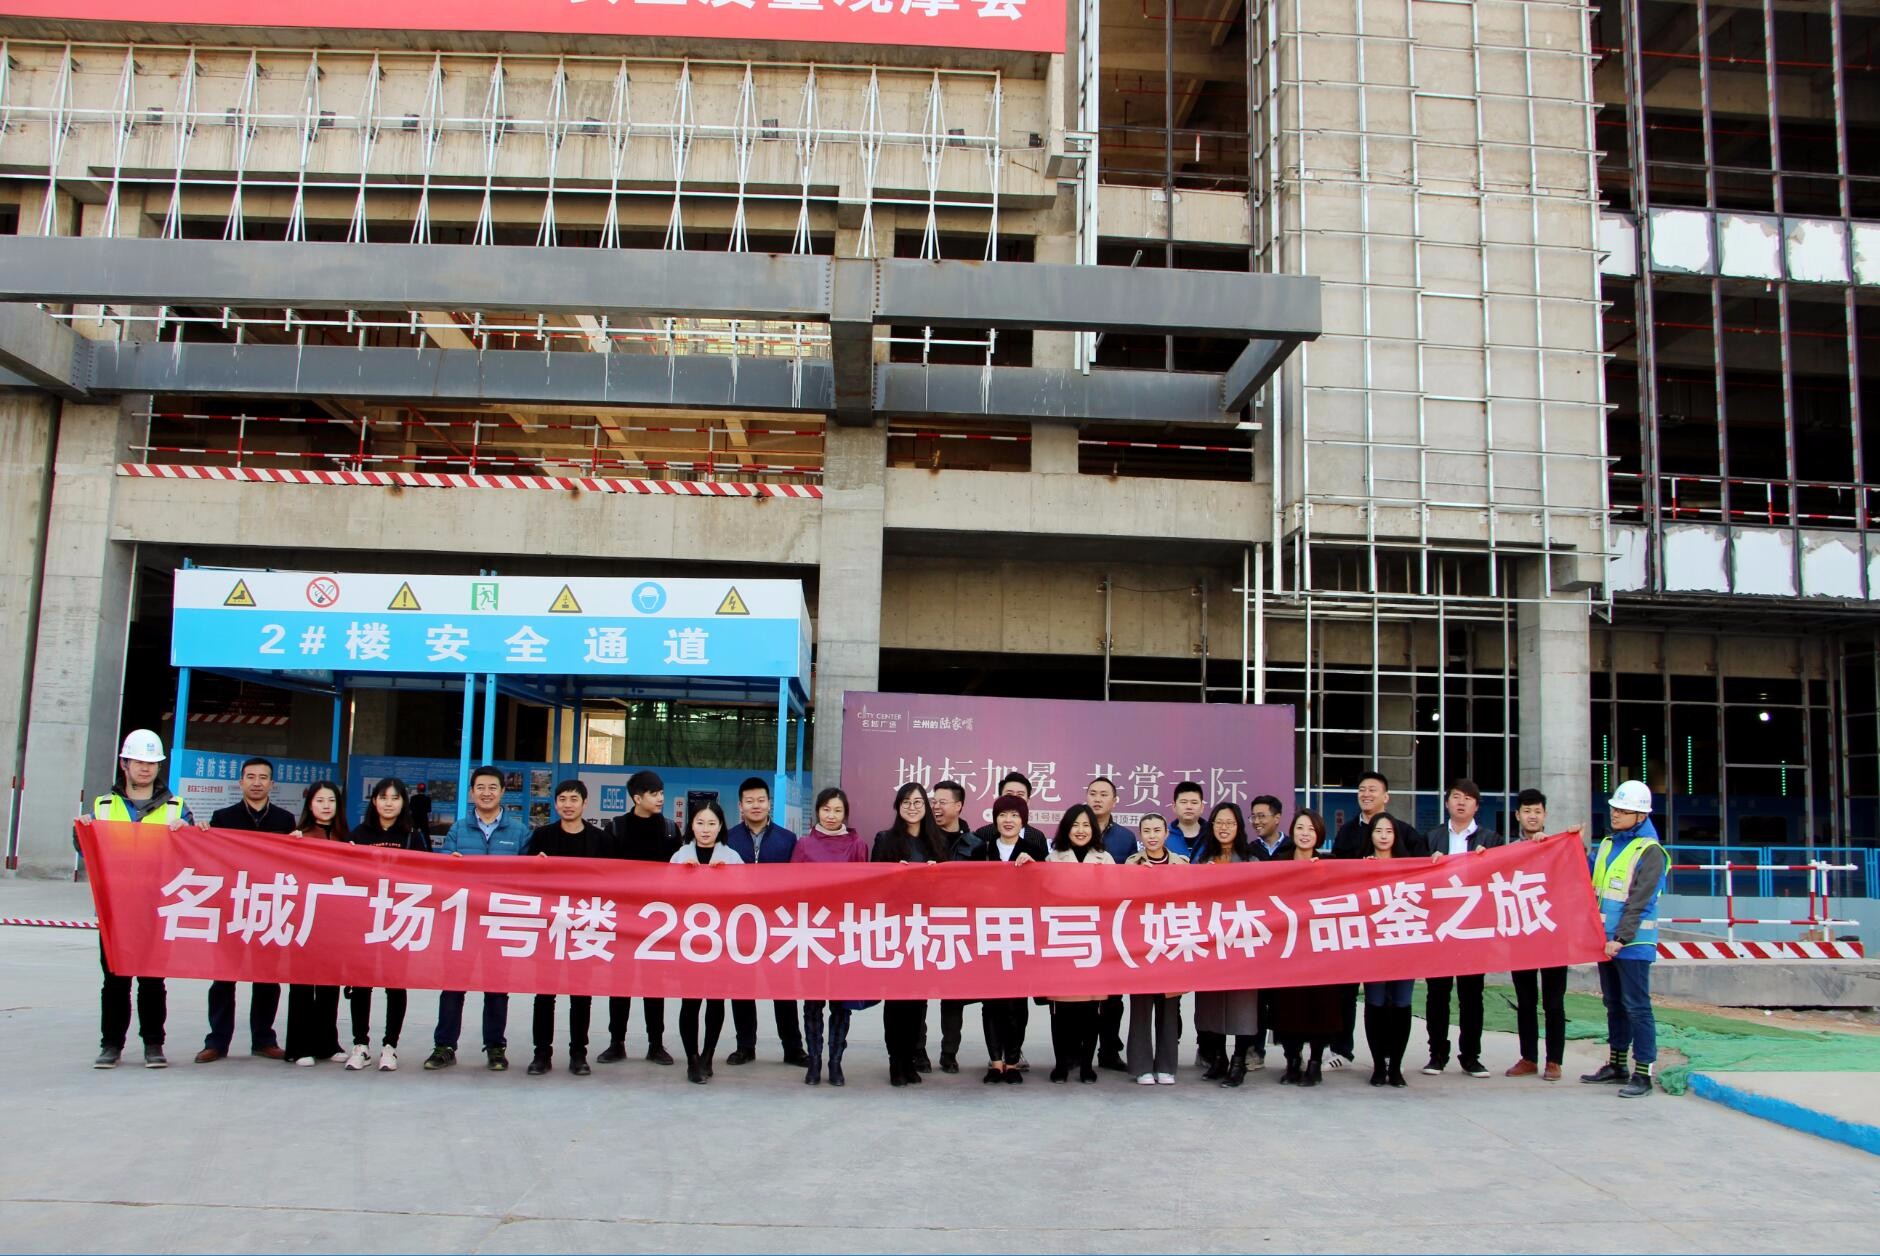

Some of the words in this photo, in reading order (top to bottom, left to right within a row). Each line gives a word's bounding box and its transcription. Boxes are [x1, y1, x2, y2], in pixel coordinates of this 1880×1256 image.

[259, 621, 709, 664] 2#楼安全通道
[157, 867, 617, 962] 名城广场1号楼
[634, 869, 1557, 970] 280米地标甲写(媒体)品鉴之旅
